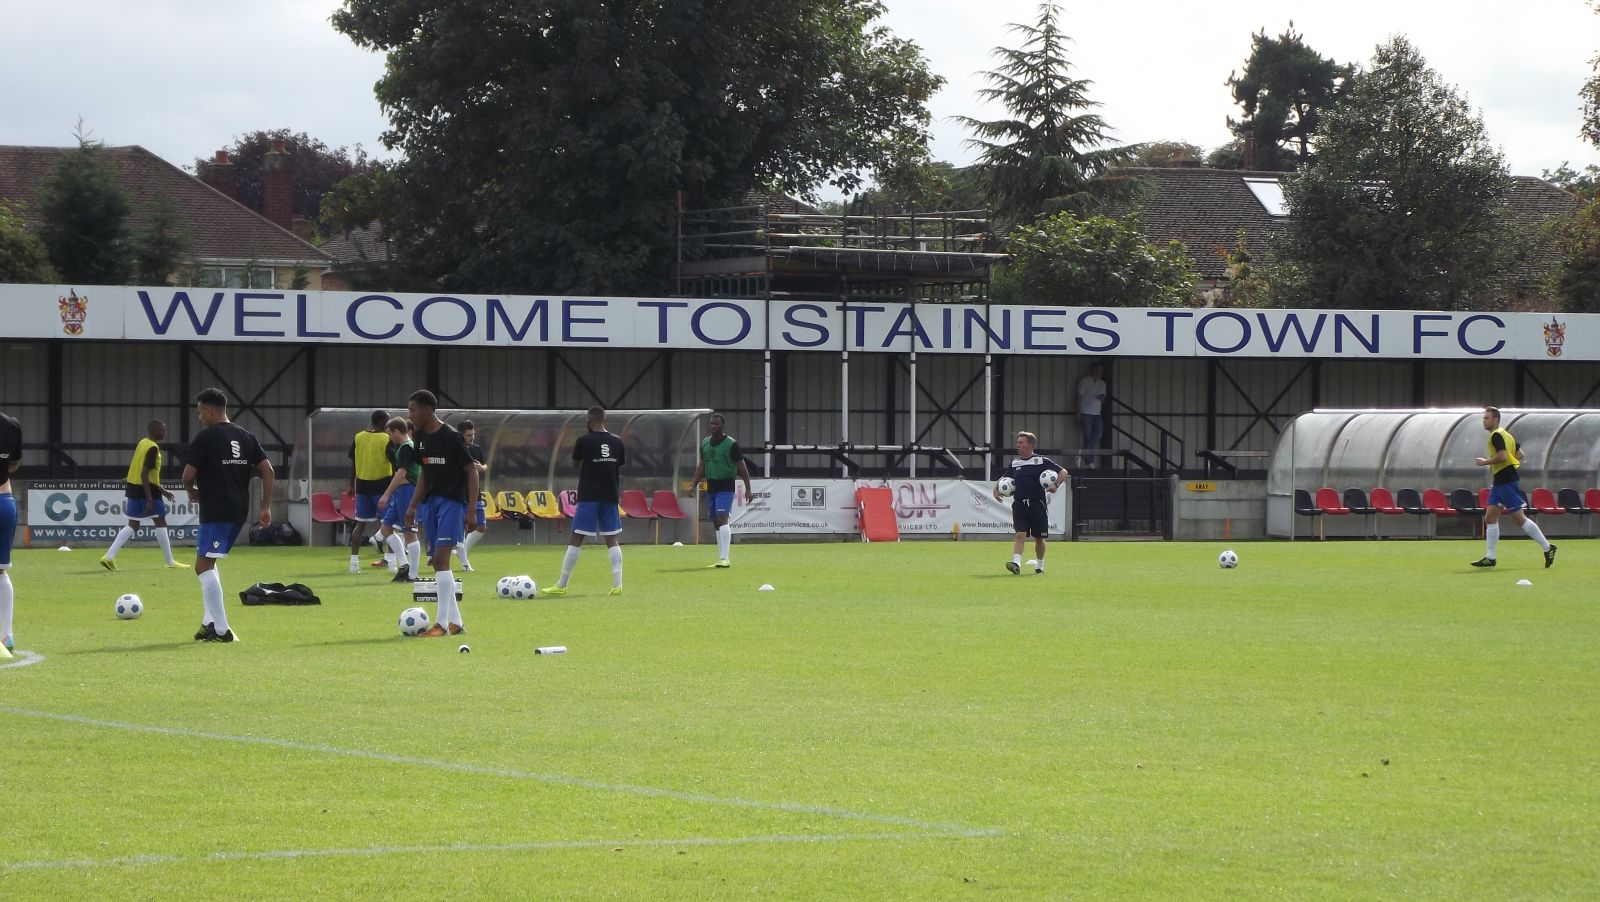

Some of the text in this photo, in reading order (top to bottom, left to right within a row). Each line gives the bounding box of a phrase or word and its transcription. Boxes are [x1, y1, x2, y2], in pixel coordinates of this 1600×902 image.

[137, 291, 1506, 356] WELCOME TO STAINES TOWN FC
[505, 492, 516, 508] 15
[535, 491, 547, 507] 14
[566, 490, 577, 506] 13
[44, 492, 89, 522] CS
